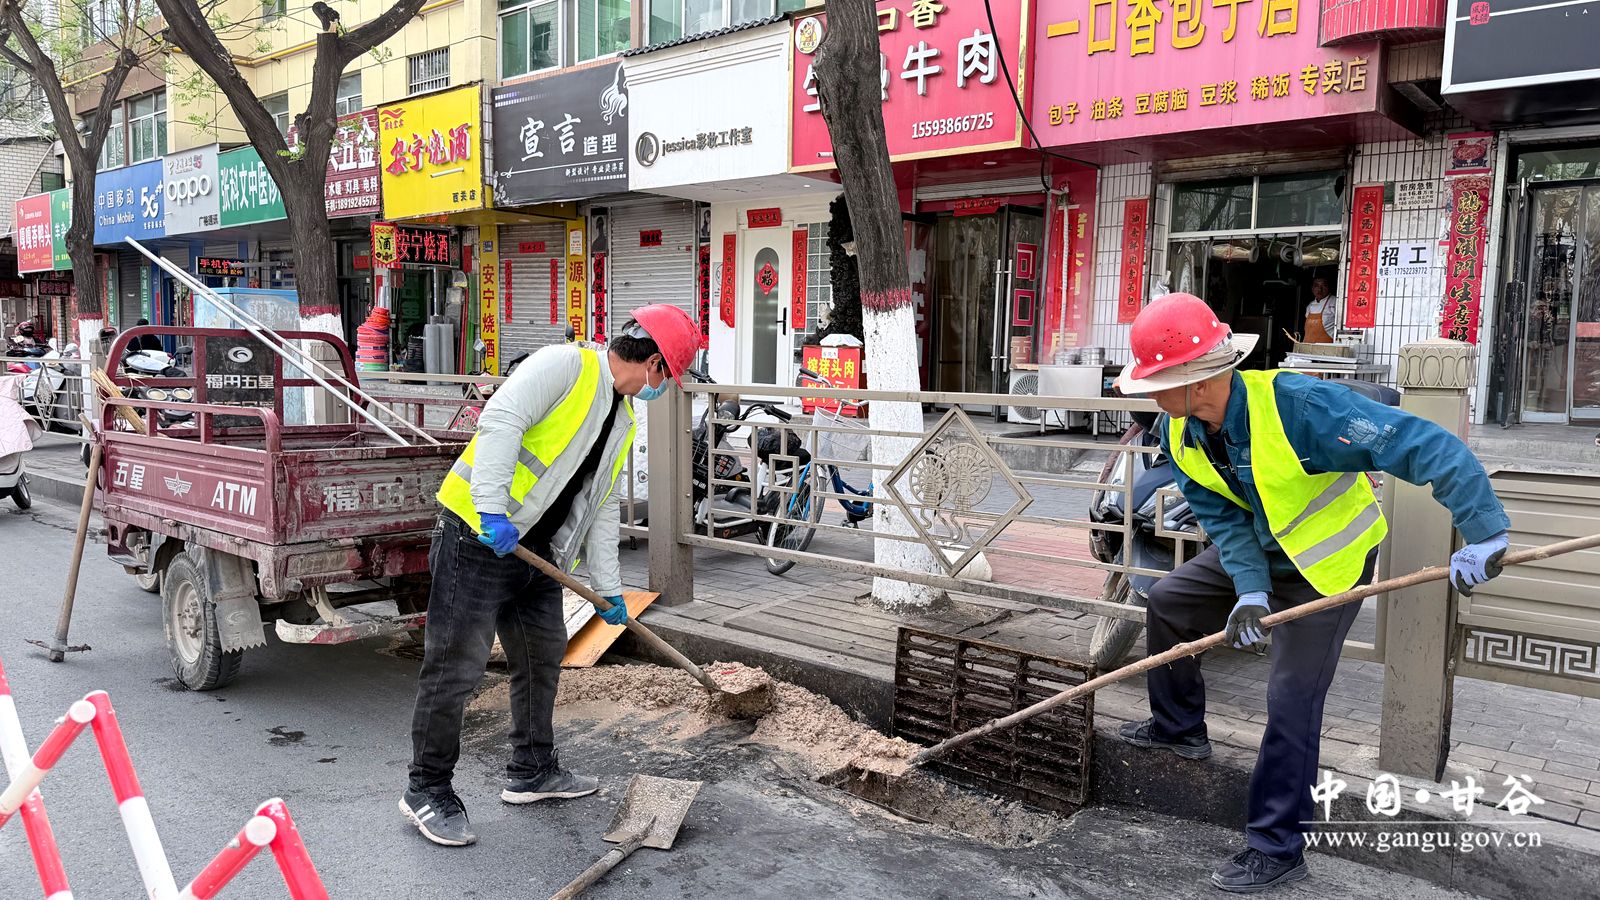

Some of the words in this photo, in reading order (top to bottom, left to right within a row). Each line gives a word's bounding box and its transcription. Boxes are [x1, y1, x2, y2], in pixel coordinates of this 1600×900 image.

[802, 28, 1000, 113] 生牛肉
[1047, 104, 1080, 125] 包子
[1090, 96, 1125, 120] 油条
[1134, 88, 1189, 115] 豆腐脑
[1199, 80, 1239, 106] 豆浆
[1250, 72, 1290, 101] 稀饭
[1299, 56, 1369, 97] 专卖店
[911, 112, 995, 139] 15593866725
[583, 133, 618, 157] 造型
[98, 186, 135, 210] 中国移动
[220, 160, 282, 213] 张科文中医诊
[98, 215, 115, 226] China
[117, 211, 135, 224] Mobile
[378, 235, 391, 251] 酒
[397, 228, 449, 263] 安宁烧酒
[1381, 246, 1427, 266] 招工
[482, 263, 496, 358] 安宁烧酒
[113, 461, 146, 491] 五星
[210, 480, 257, 517] ATM
